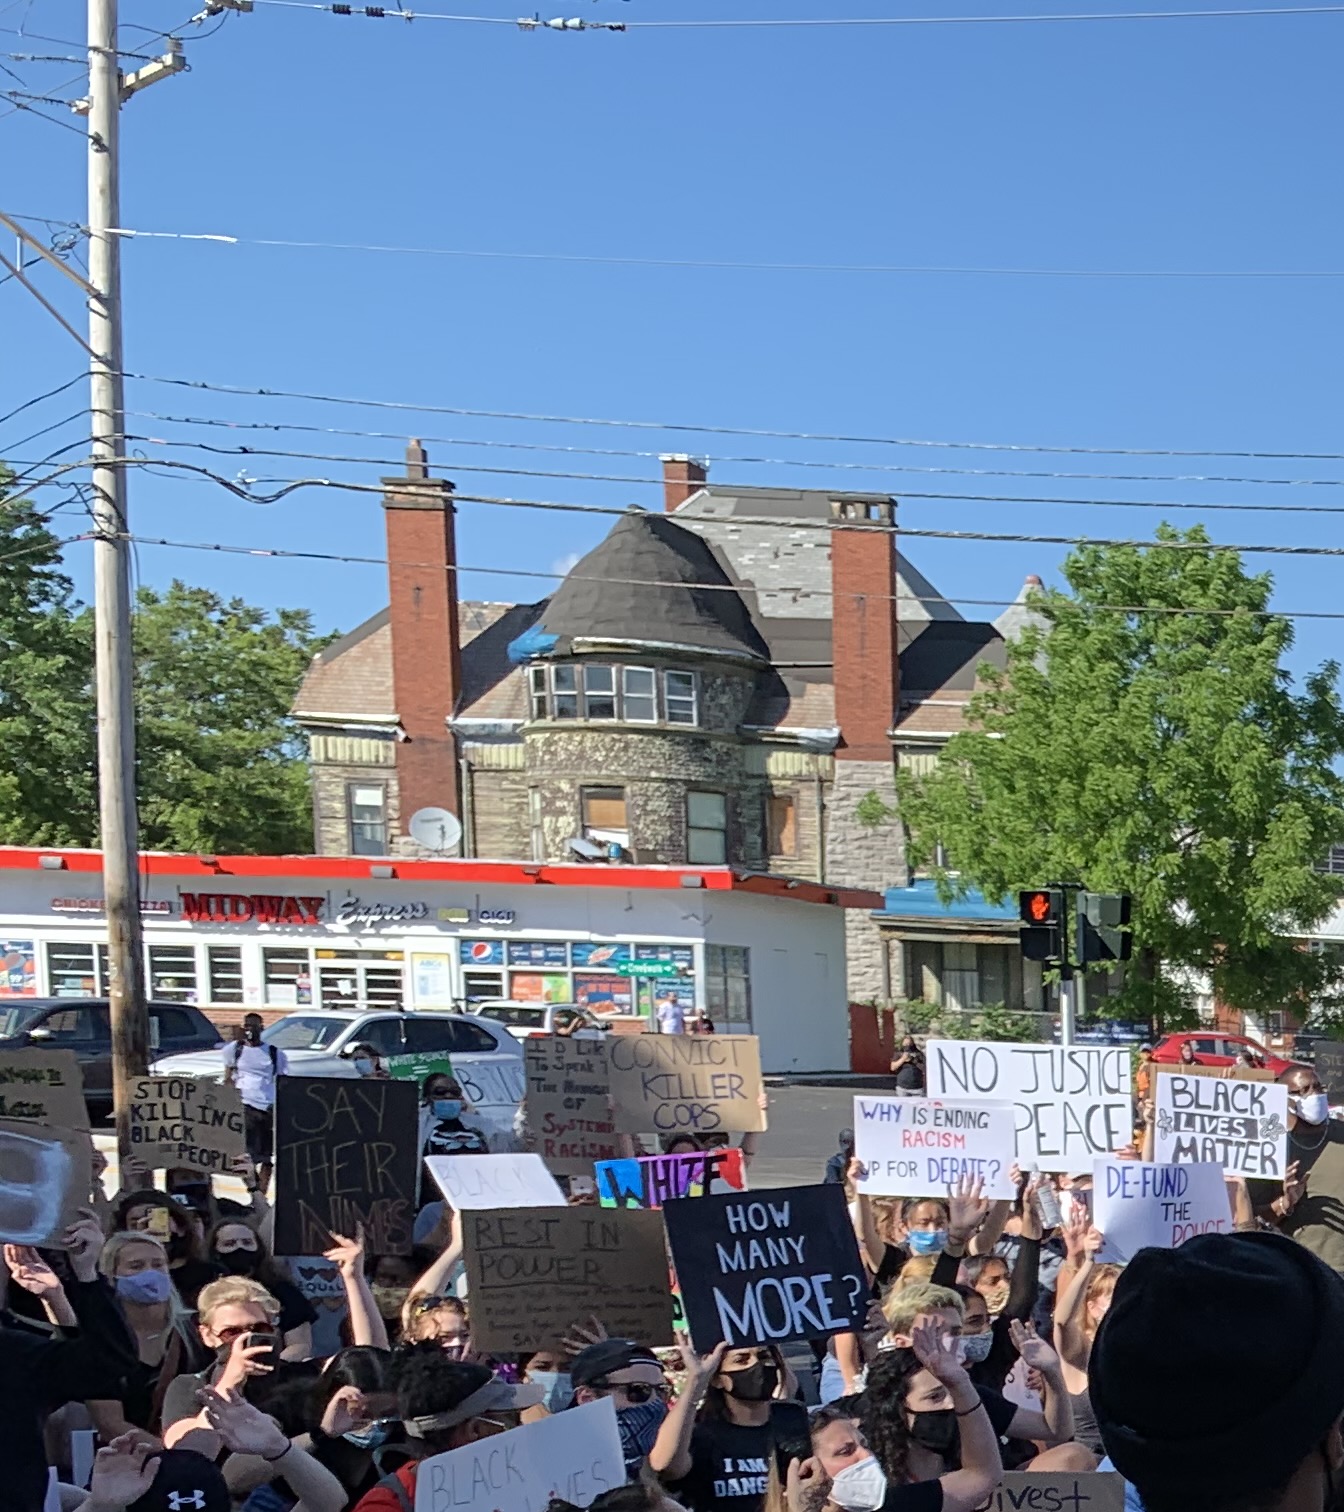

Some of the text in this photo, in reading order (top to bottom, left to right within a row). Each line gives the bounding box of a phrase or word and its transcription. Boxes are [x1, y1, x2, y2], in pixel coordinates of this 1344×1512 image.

[179, 892, 325, 925] MIDWAY
[337, 896, 430, 927] Express
[610, 1037, 748, 1071] CONVICT
[640, 1073, 748, 1101] KILLER
[937, 1046, 1131, 1096] NO JUSTICE
[134, 1079, 196, 1100] STOP
[1170, 1076, 1268, 1116] BLACK
[130, 1103, 243, 1133] KILLING
[291, 1084, 385, 1134] SAY
[653, 1103, 722, 1130] COPS
[860, 1101, 991, 1129] WHY IS ENDING
[1180, 1113, 1247, 1138] LIVES
[131, 1123, 194, 1143] BLACK
[902, 1129, 966, 1150] RACISM
[1014, 1101, 1128, 1158] PEACE
[177, 1143, 236, 1171] PEOPL
[281, 1137, 403, 1195] THEIR
[887, 1160, 918, 1178] FOR
[1171, 1135, 1280, 1176] MATTER
[603, 1153, 729, 1209] WHITE
[1106, 1165, 1189, 1199] DE-FUND
[725, 1201, 790, 1234] HOW
[1161, 1202, 1192, 1222] THE
[474, 1216, 621, 1248] REST IN
[477, 1251, 602, 1284] POWER
[716, 1235, 805, 1274] MANY
[712, 1273, 861, 1345] MORE?
[724, 1457, 768, 1473] I AM
